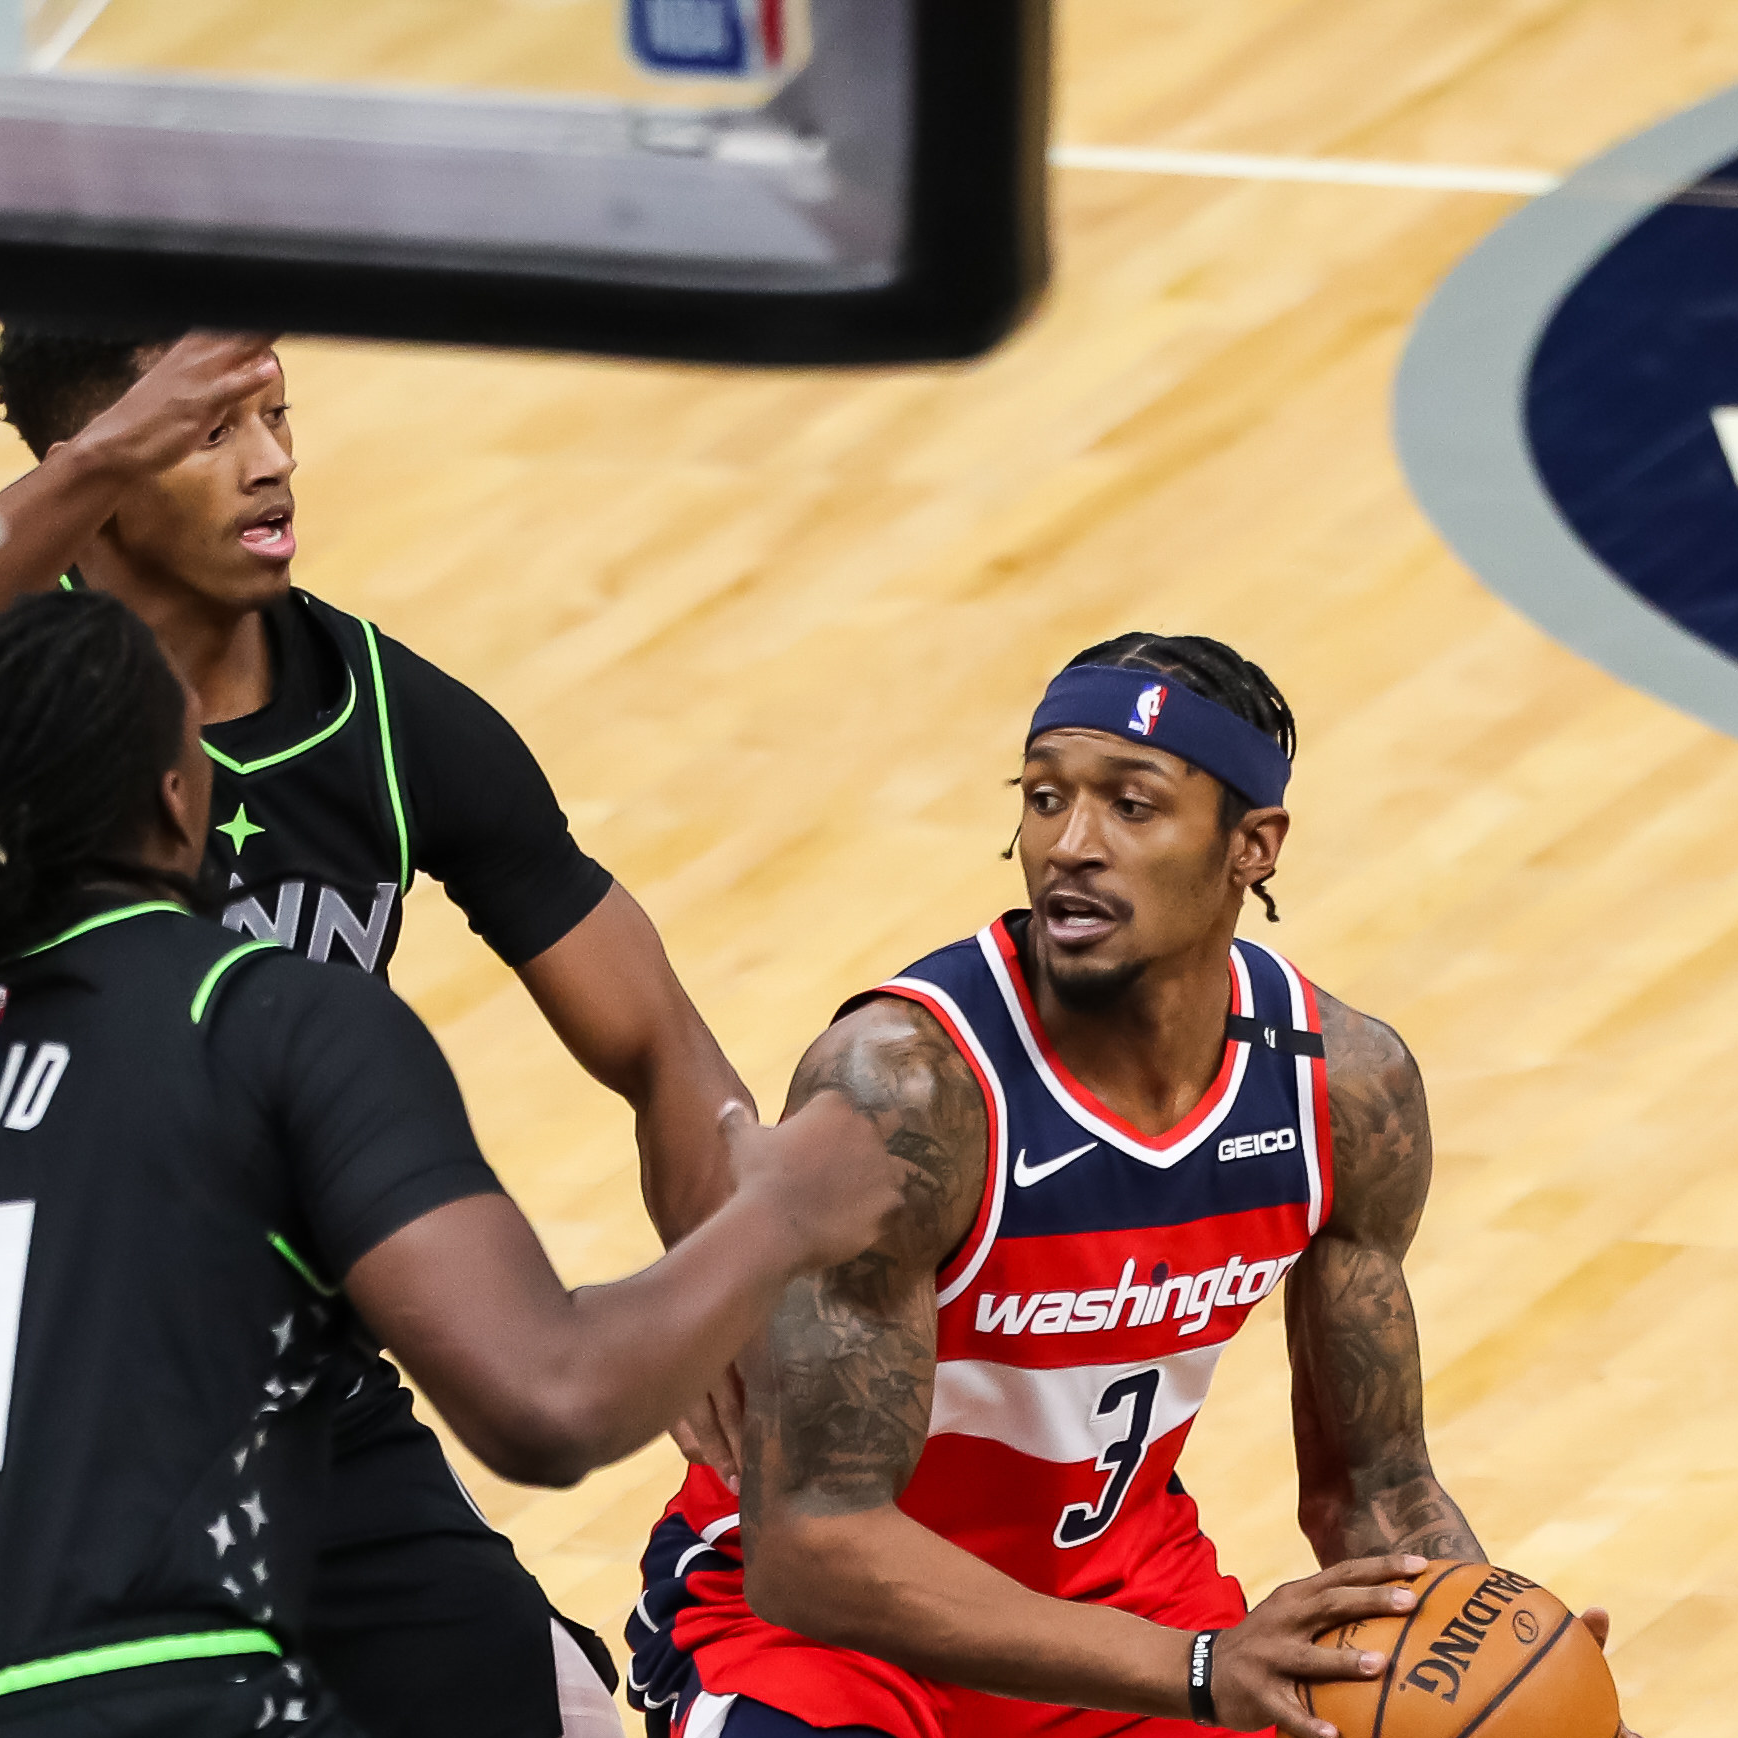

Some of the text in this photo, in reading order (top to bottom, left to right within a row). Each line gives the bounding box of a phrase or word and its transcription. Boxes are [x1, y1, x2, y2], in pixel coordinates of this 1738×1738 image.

[1218, 1128, 1297, 1162] GEICO
[975, 1251, 1303, 1336] washington
[1052, 1367, 1162, 1549] 3
[1192, 1634, 1212, 1687] Believe
